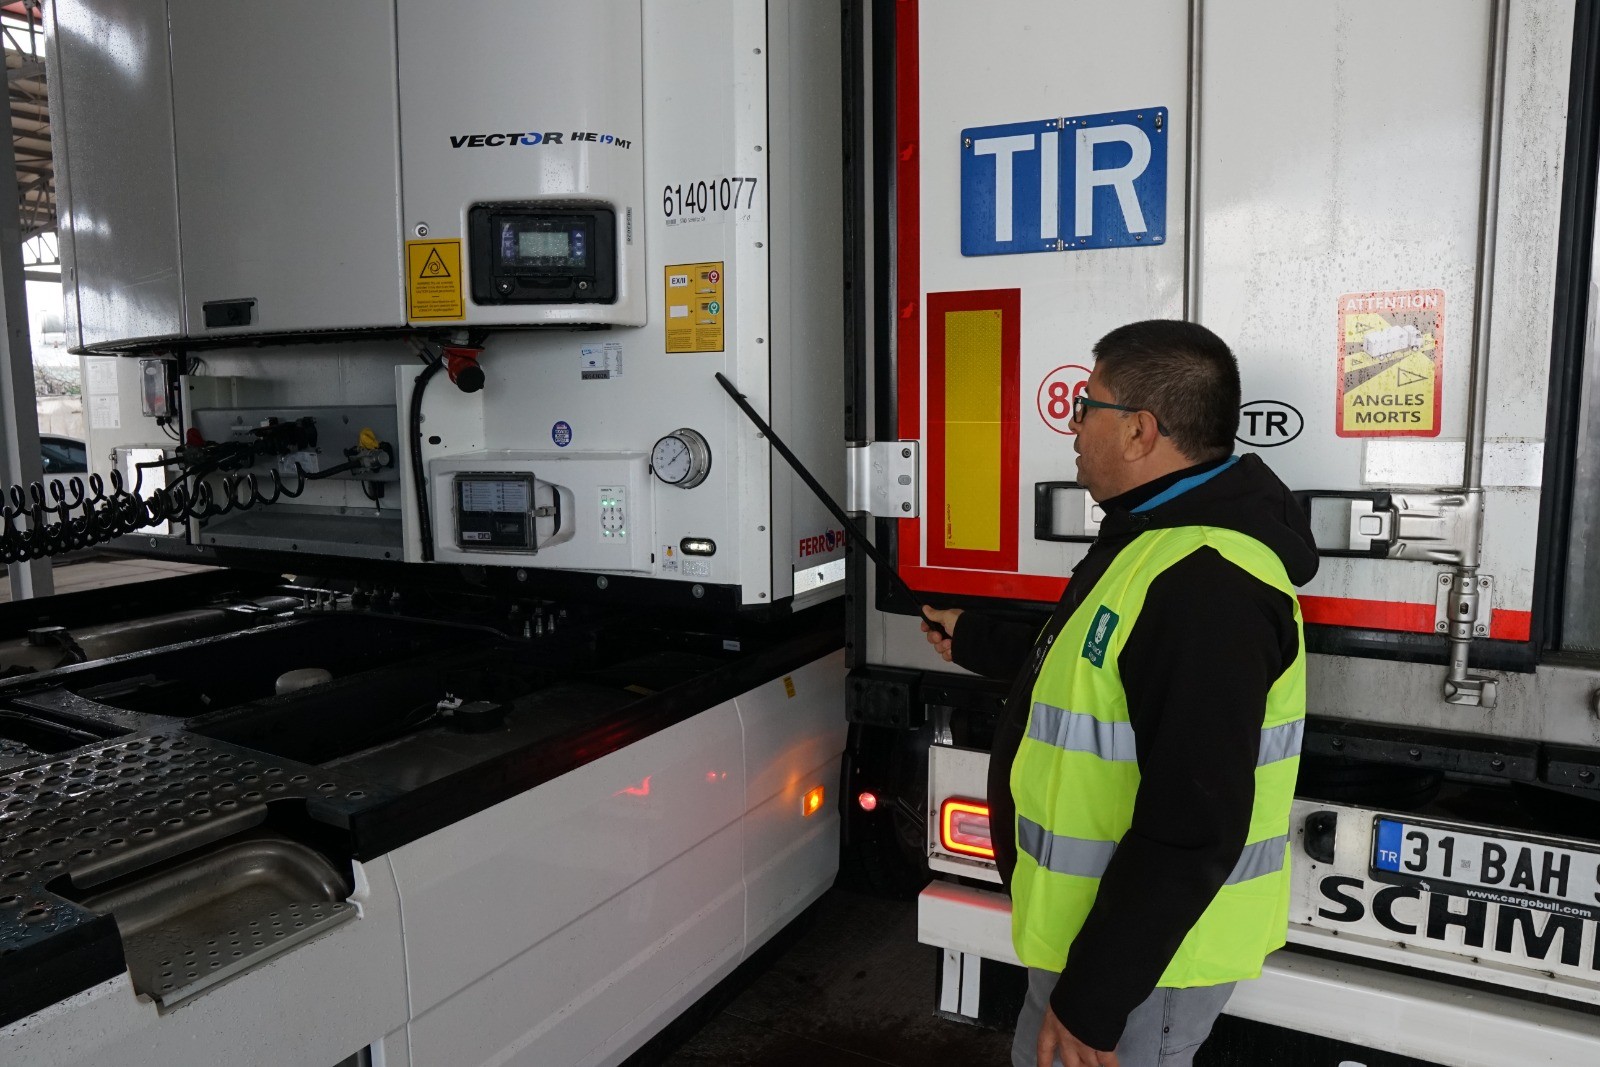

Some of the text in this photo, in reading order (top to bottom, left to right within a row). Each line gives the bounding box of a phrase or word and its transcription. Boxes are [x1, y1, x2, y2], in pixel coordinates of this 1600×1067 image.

[450, 132, 632, 150] VECTOR HE 19 MT
[974, 124, 1152, 242] TIR
[663, 177, 758, 217] 61401077
[1346, 294, 1438, 310] ATTENTION
[1352, 393, 1425, 407] ANGLES
[1243, 411, 1289, 436] TR
[1355, 411, 1421, 424] MORTS
[1379, 850, 1398, 863] TR
[1404, 830, 1455, 878] 31
[1480, 841, 1571, 898] BAH
[1466, 888, 1592, 917] www.cargobull.com
